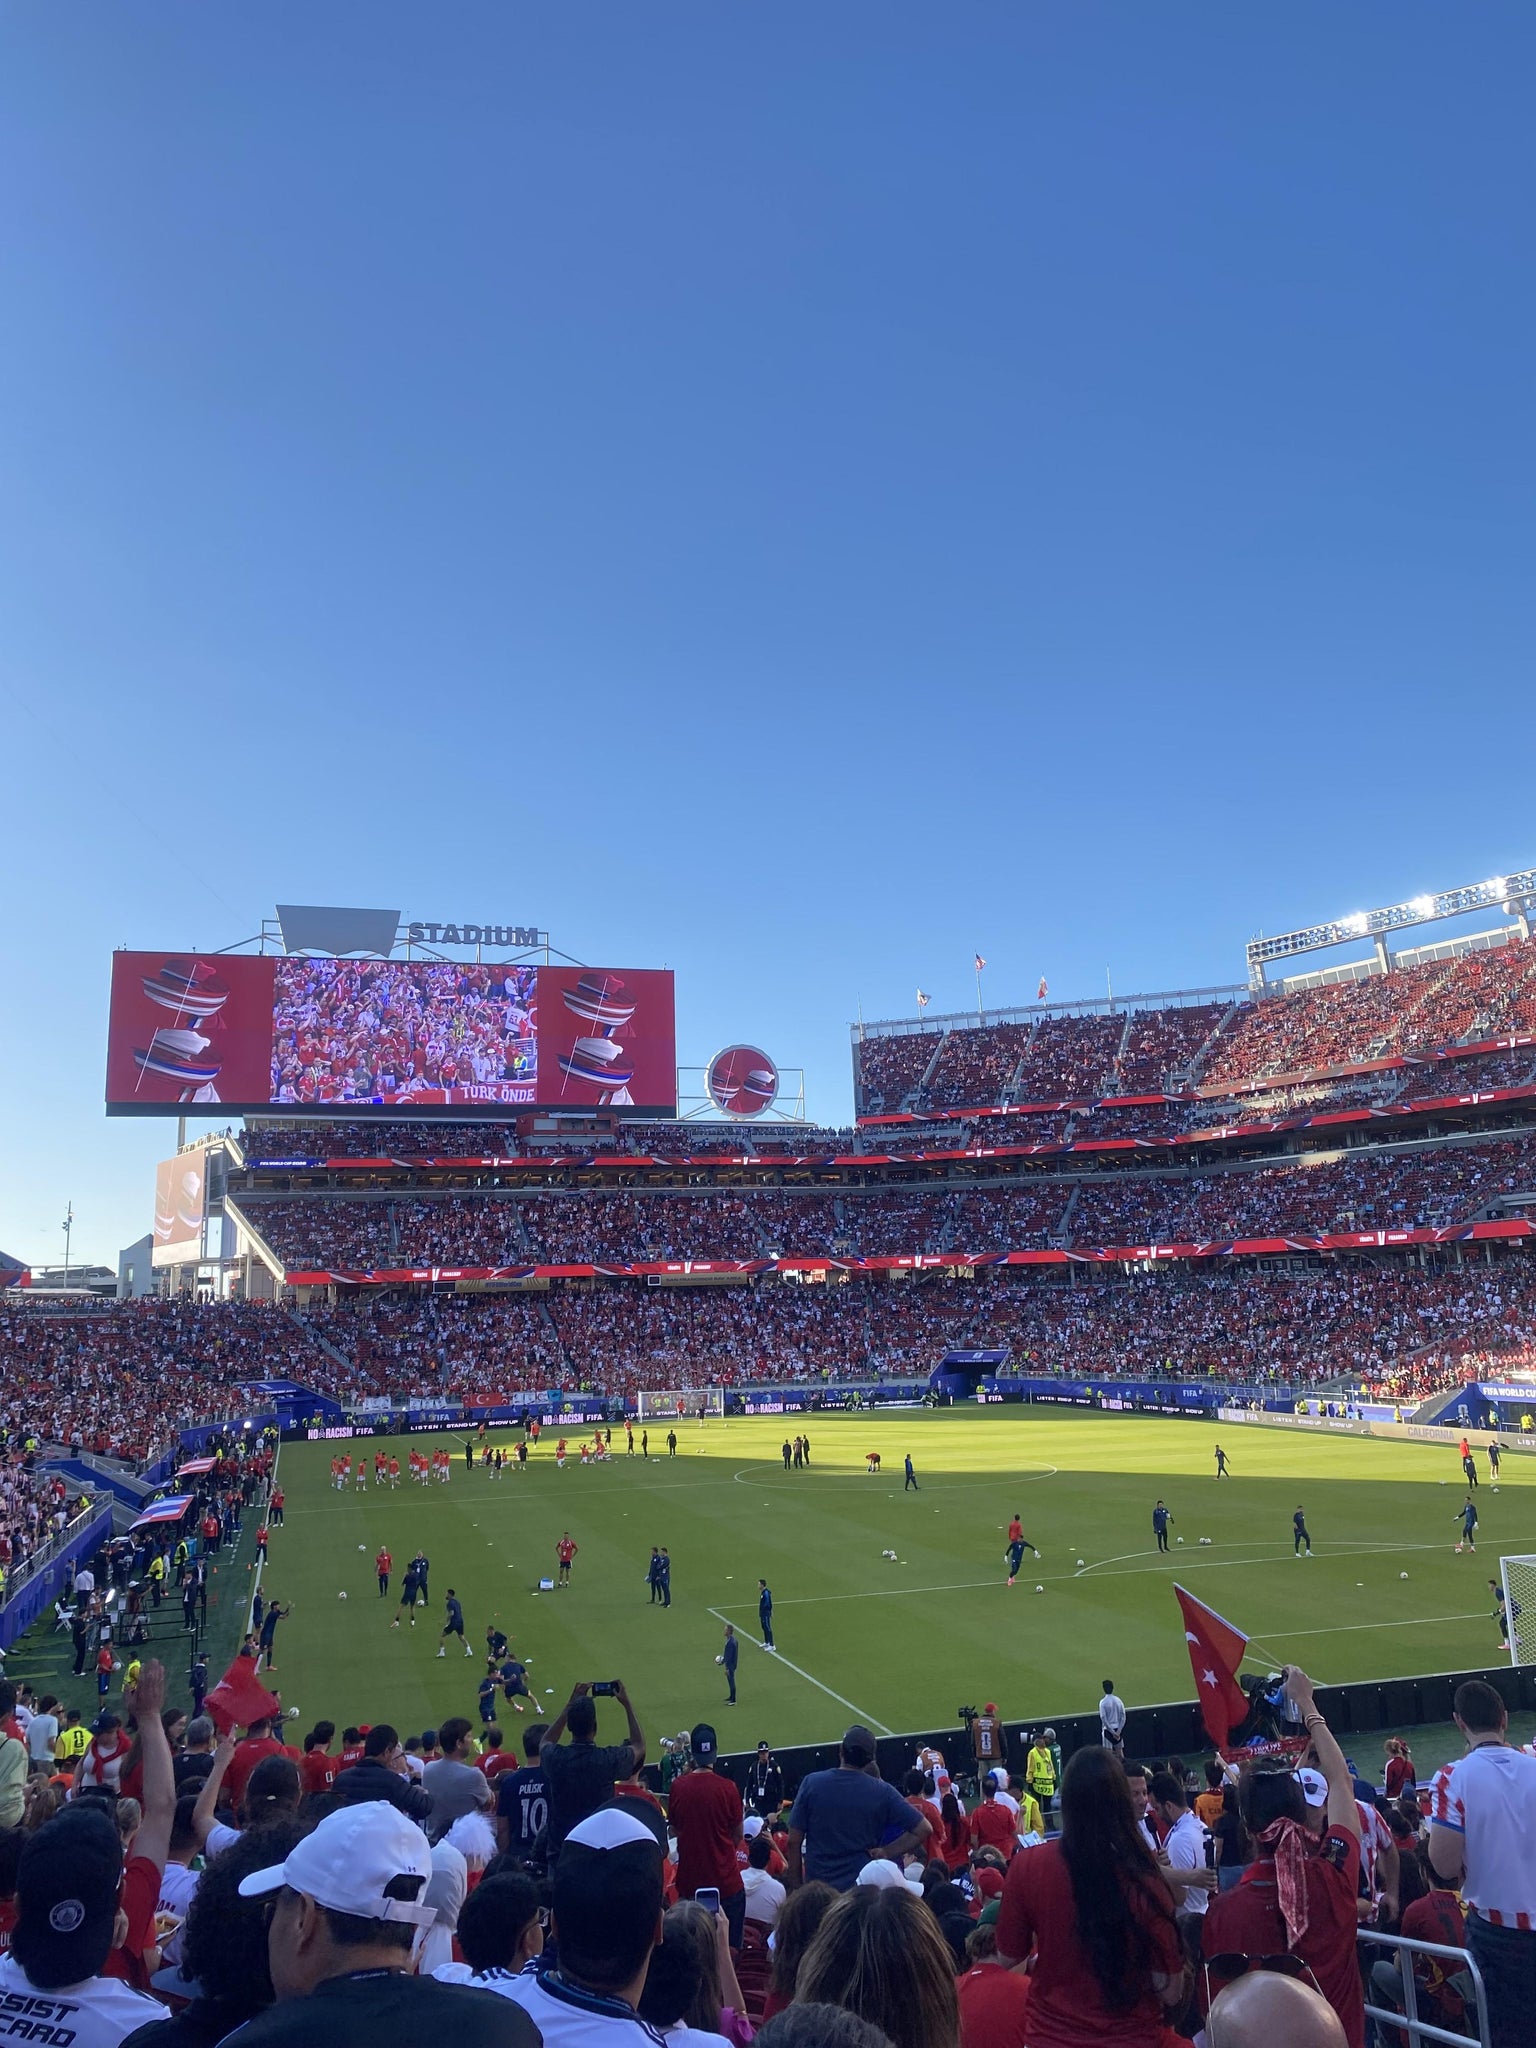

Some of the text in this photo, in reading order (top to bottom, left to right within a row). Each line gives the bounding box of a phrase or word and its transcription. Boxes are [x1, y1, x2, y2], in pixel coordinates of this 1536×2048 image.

[409, 922, 538, 947] STADIUM
[1482, 1386, 1498, 1396] FIFA
[1499, 1388, 1524, 1397] WORLD
[745, 1404, 754, 1414] NO
[542, 1415, 552, 1425] NO
[563, 1414, 584, 1424] RACISM
[308, 1429, 318, 1440] NO
[326, 1427, 352, 1439] RACISM
[1408, 1427, 1454, 1440] CALIFORNIA
[521, 1798, 548, 1838] 10
